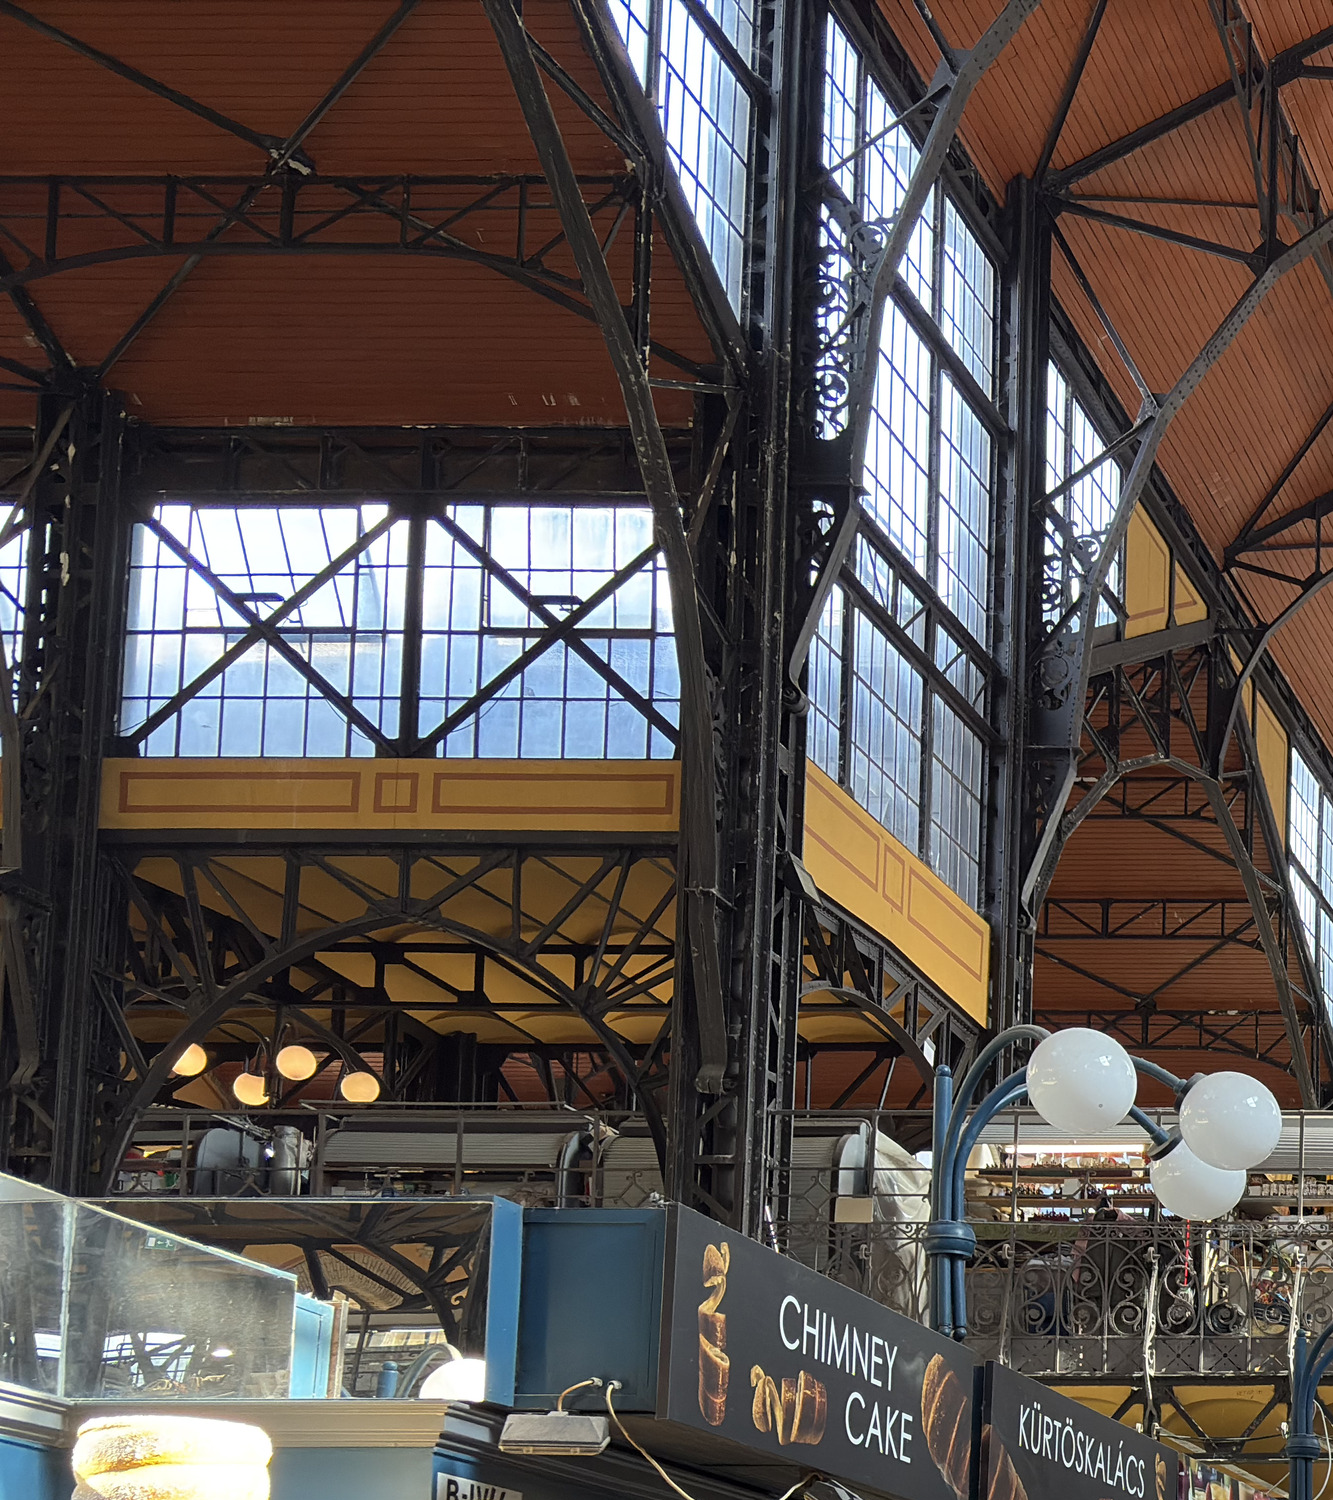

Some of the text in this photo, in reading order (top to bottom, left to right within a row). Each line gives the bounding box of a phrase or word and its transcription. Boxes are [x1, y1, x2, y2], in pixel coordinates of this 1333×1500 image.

[779, 1295, 898, 1391] CHIMNEY
[845, 1391, 913, 1464] CAKE
[1018, 1402, 1146, 1499] KÜRTÖSKALÁCS
